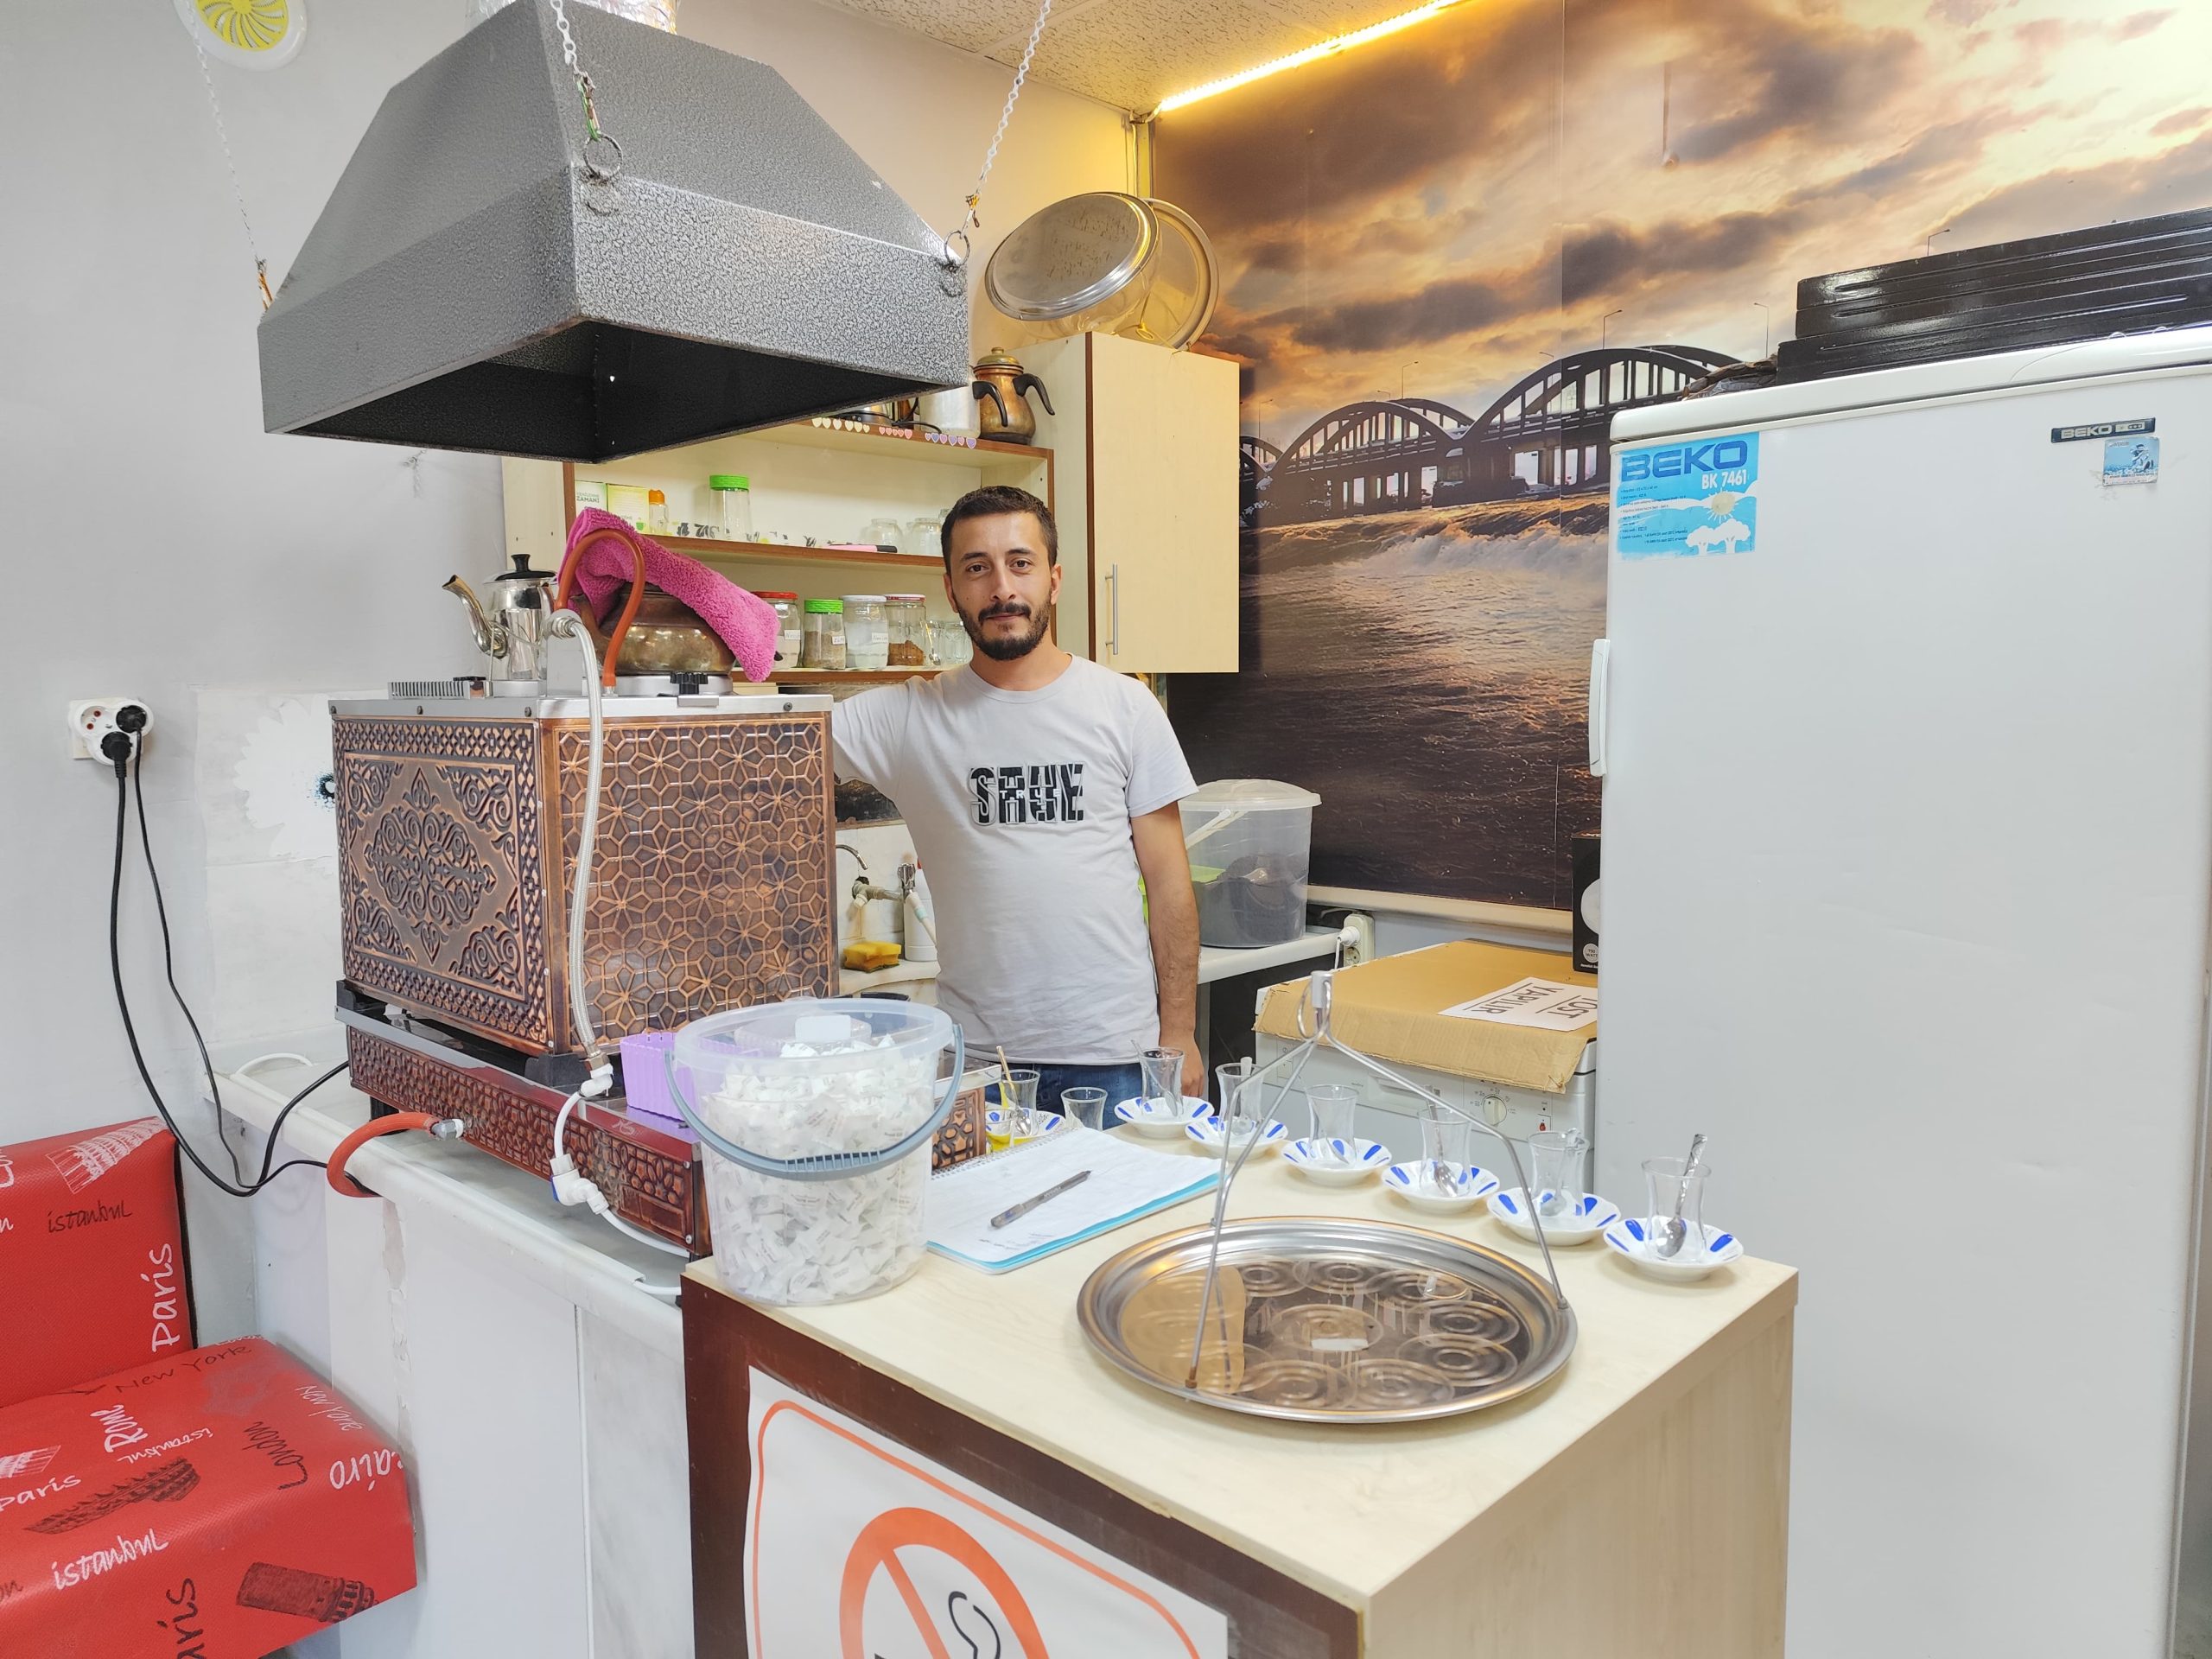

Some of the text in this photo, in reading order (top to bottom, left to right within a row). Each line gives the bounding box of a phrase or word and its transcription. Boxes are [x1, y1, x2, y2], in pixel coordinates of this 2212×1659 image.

[2061, 424, 2113, 439] BEKO
[1621, 440, 1748, 482] BEKO
[1701, 469, 1747, 490] BK 7461
[1471, 986, 1565, 1015] YAPILIR
